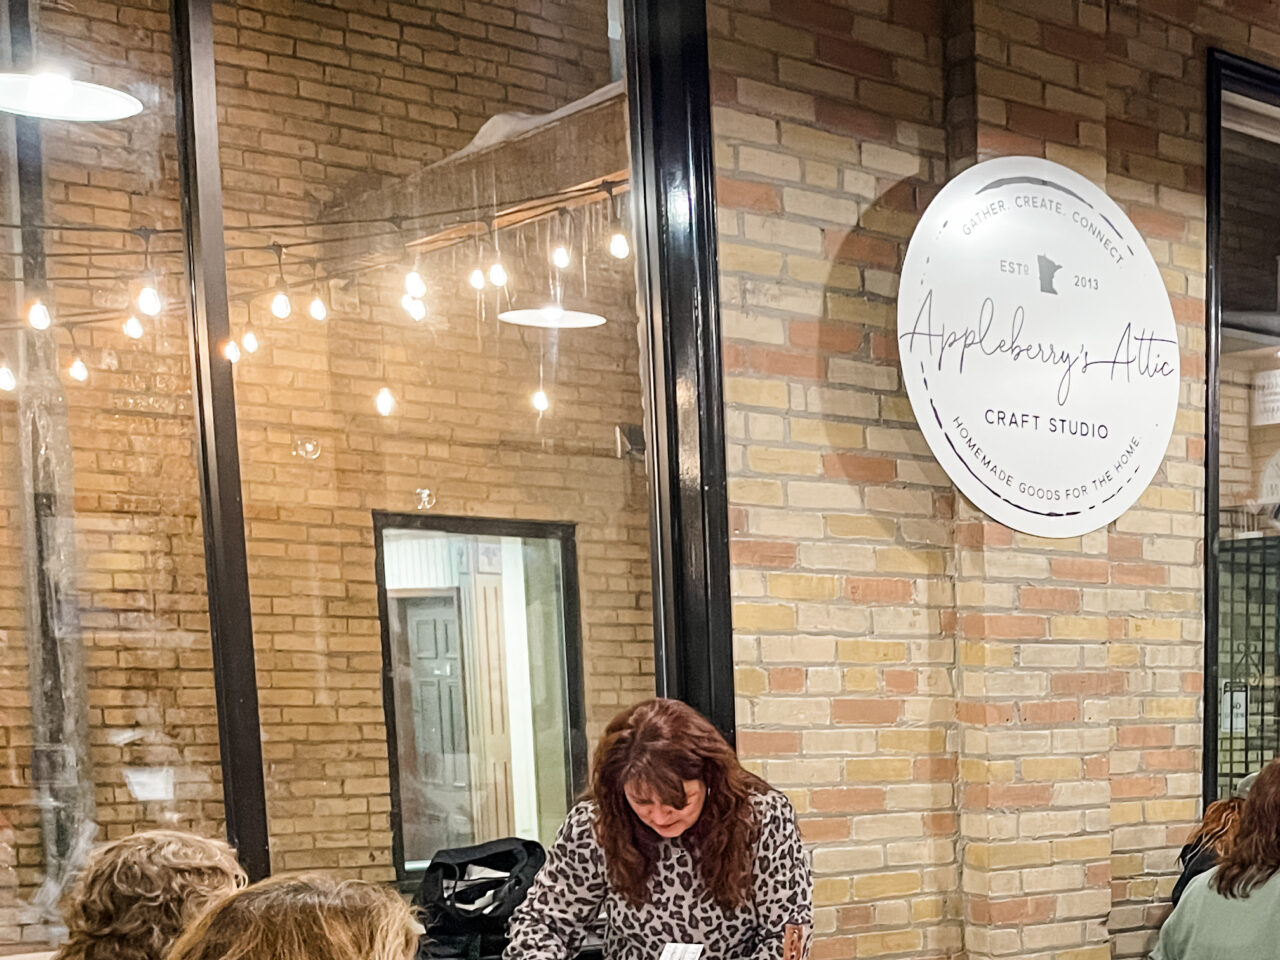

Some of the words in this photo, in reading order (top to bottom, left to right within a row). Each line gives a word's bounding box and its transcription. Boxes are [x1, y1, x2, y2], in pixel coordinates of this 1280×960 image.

[1074, 275, 1100, 291] 2013
[899, 289, 1091, 406] Appleberry's
[1098, 322, 1178, 383] Attic
[985, 409, 1040, 431] CRAFT
[1049, 417, 1109, 440] STUDIO
[953, 416, 1012, 487] HOMEMADE
[1019, 480, 1062, 501] GOODS
[1066, 484, 1089, 499] FOR
[1093, 468, 1114, 491] THE
